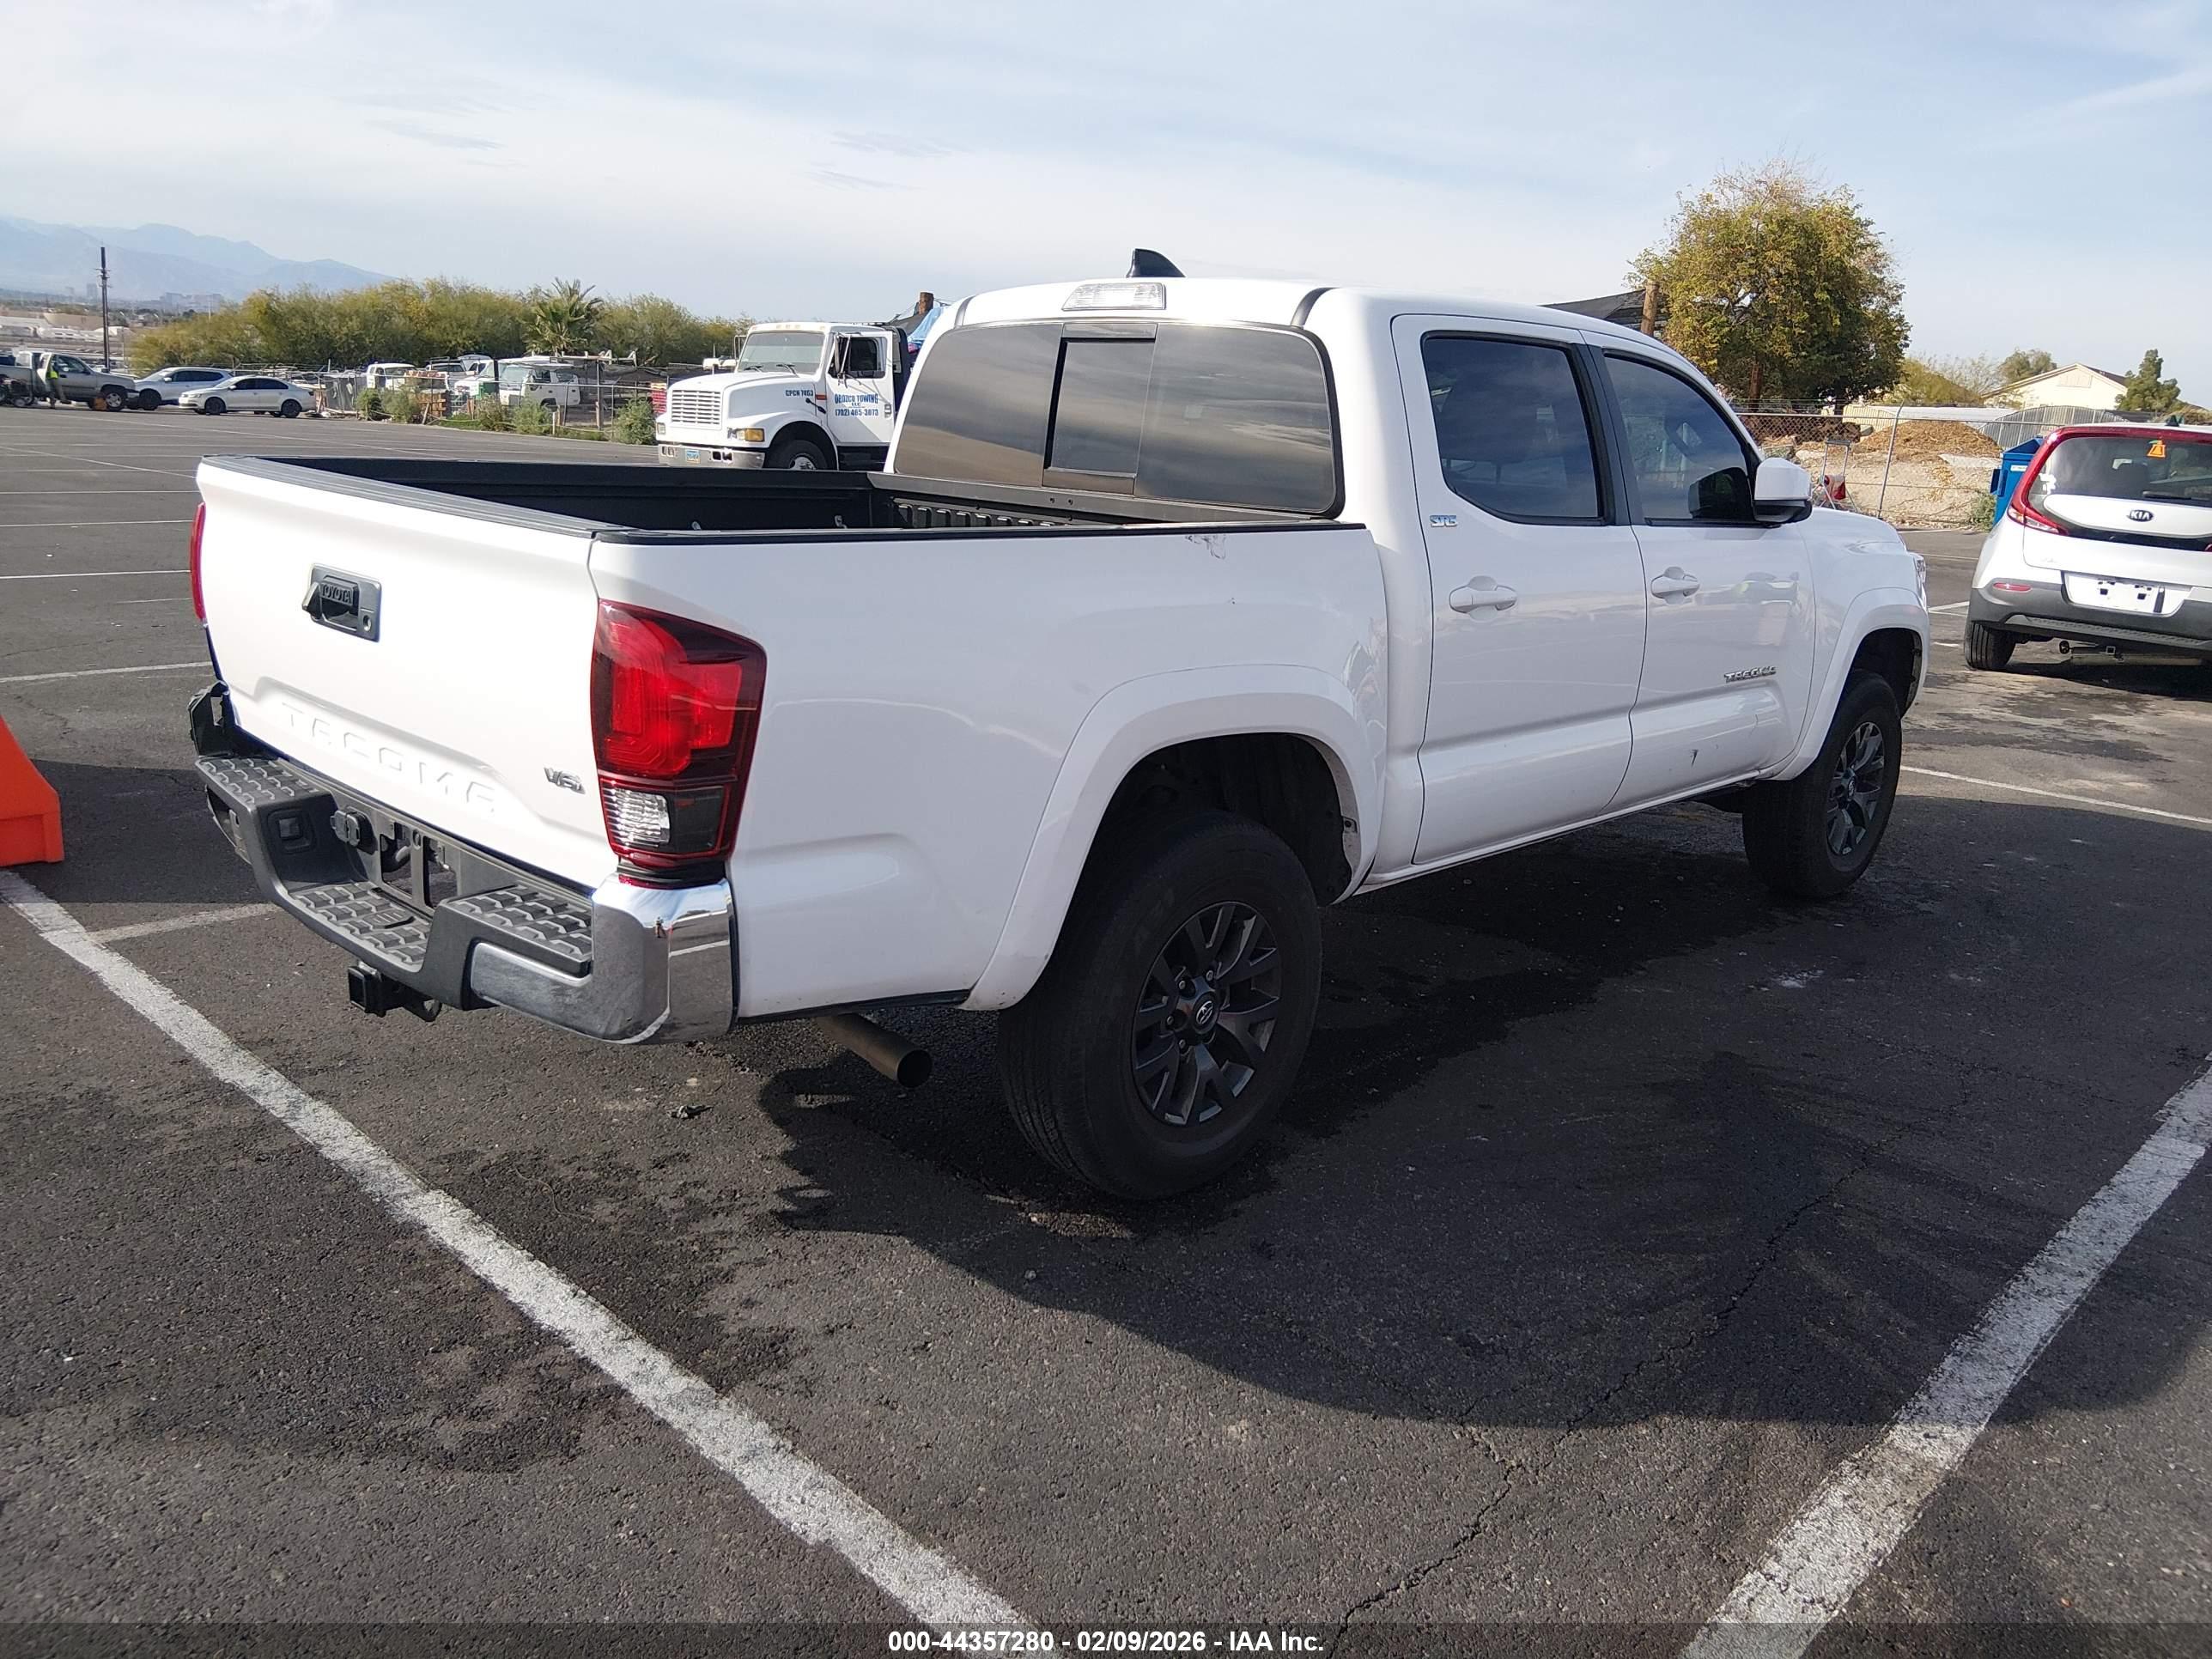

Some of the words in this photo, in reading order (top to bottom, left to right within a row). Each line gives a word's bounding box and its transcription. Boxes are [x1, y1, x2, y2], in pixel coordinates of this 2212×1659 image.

[856, 393, 878, 404] TOWING
[835, 408, 850, 416] (702)
[2130, 510, 2150, 520] KIA
[322, 584, 353, 605] TOYOTA
[1723, 665, 1777, 684] TACOMA
[281, 701, 496, 814] TACOMA
[544, 767, 586, 794] V6
